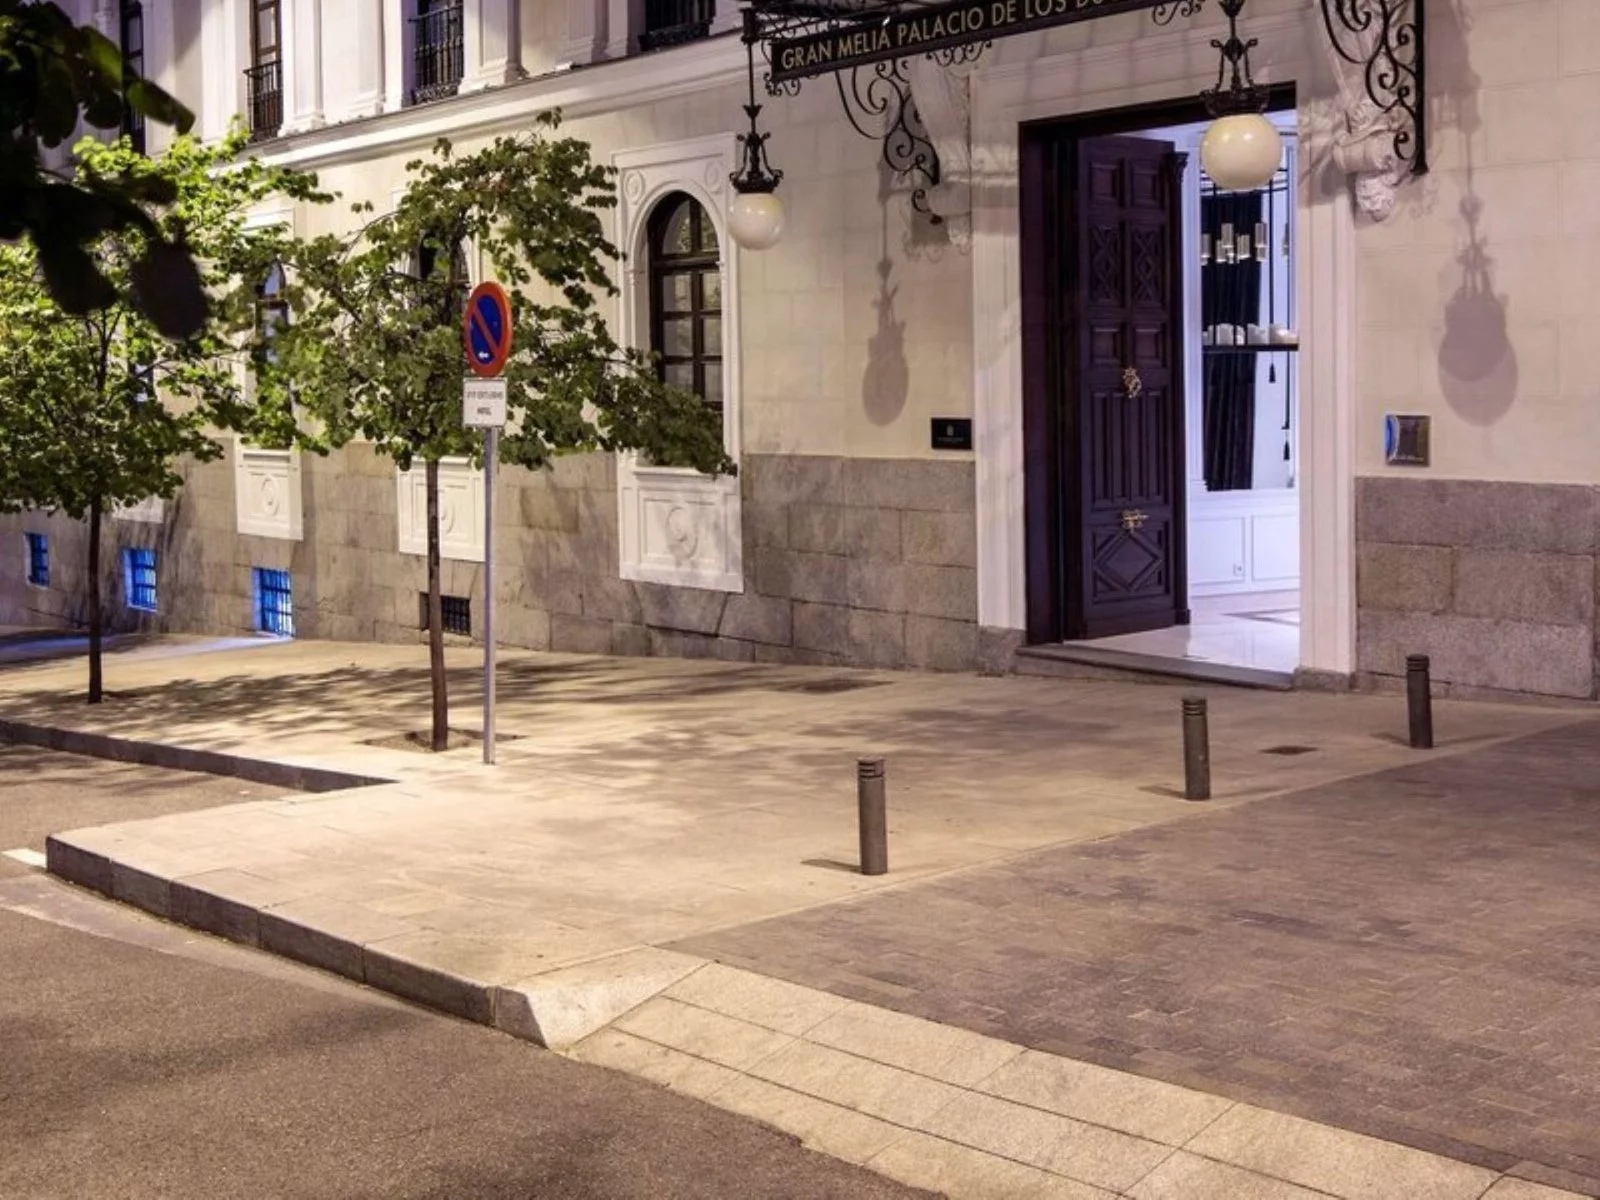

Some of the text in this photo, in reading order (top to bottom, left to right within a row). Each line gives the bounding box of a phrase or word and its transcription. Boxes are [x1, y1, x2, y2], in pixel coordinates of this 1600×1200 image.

[780, 40, 832, 70] GRAN
[896, 5, 985, 46] PALACIO
[991, 0, 1018, 26] DE
